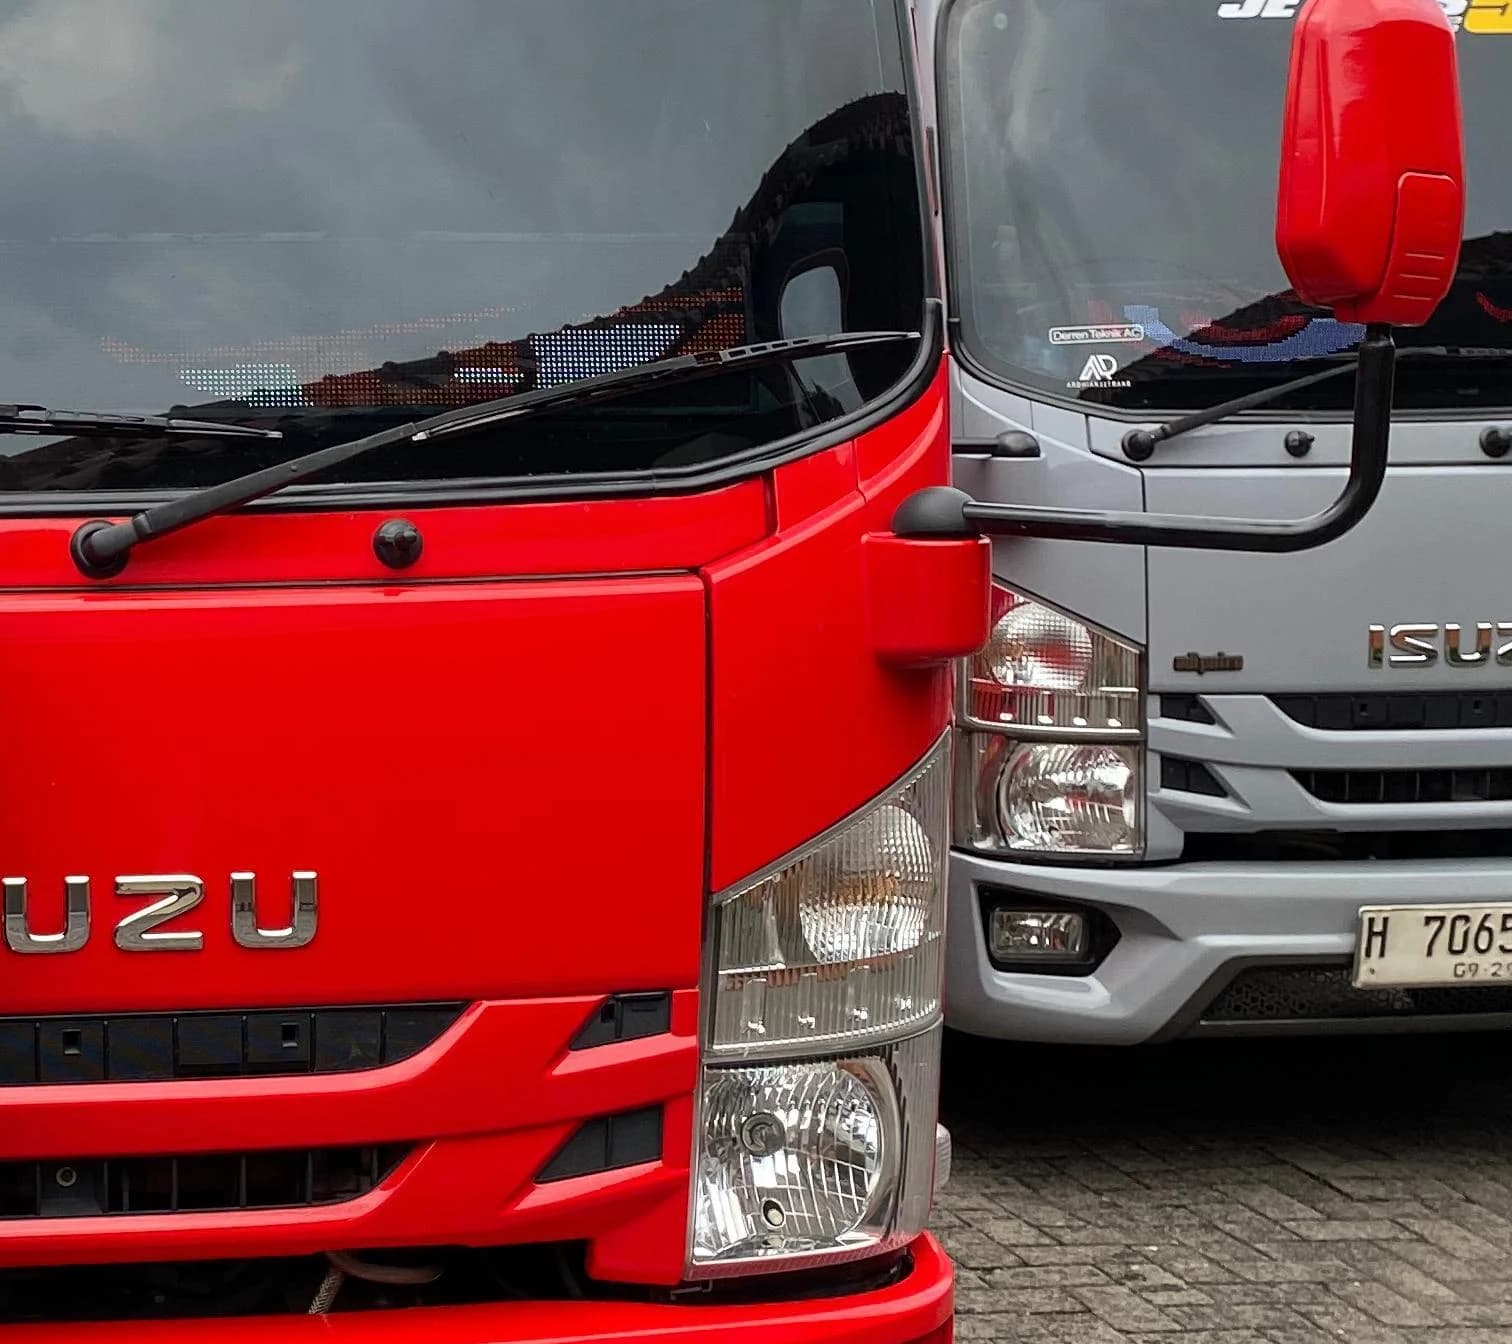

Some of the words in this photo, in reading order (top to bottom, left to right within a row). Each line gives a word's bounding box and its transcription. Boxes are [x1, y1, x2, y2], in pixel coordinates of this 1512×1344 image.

[1124, 328, 1141, 337] AC
[1365, 916, 1390, 958] H
[1424, 913, 1512, 958] 7065
